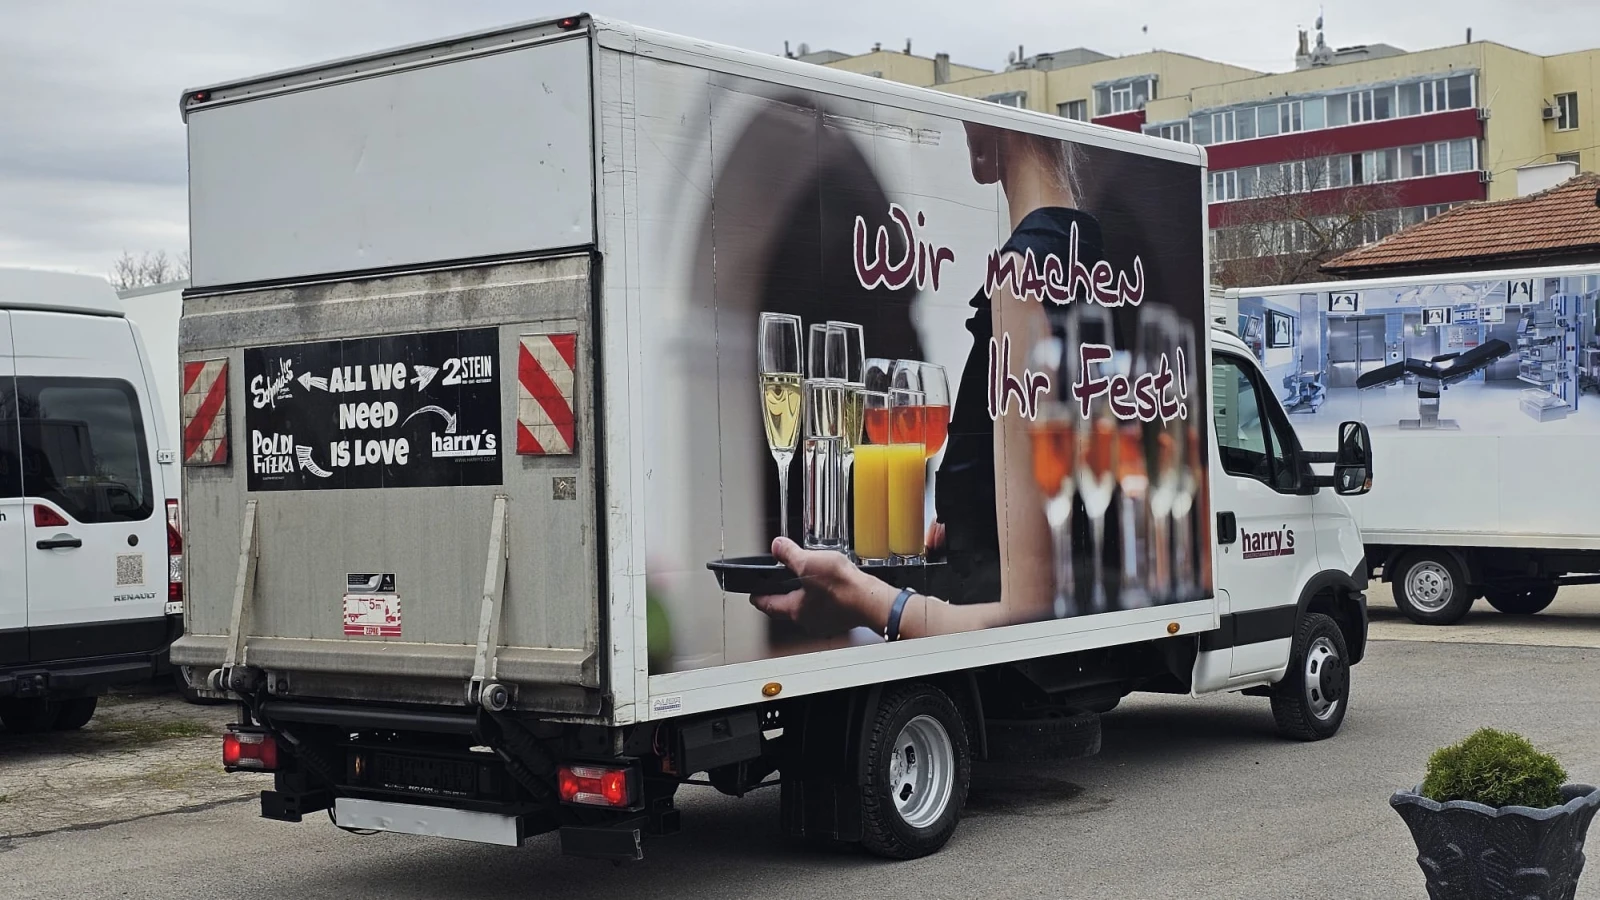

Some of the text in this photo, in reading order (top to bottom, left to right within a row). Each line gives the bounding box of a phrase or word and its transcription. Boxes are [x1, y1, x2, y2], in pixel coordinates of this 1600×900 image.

[853, 203, 955, 291] Wir
[329, 365, 367, 393] ALL
[988, 332, 1188, 427] Ihr Fest!
[330, 440, 350, 467] IS
[113, 592, 157, 602] RENAULT
